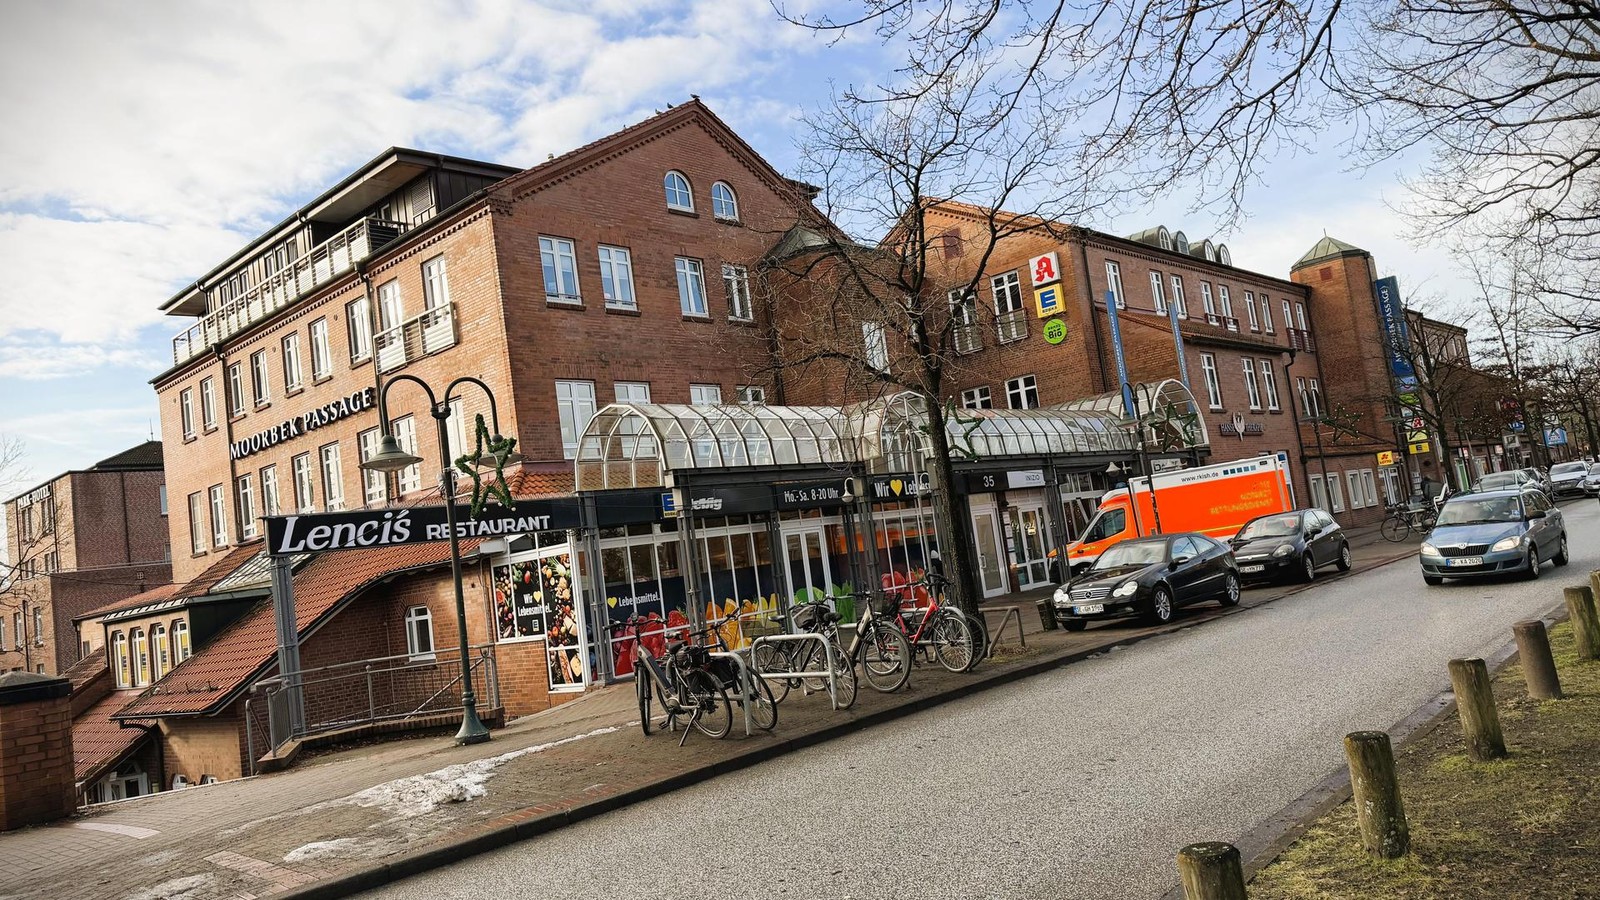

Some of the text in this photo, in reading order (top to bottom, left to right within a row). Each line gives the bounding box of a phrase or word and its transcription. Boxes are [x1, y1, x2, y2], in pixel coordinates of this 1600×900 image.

[230, 387, 373, 460] MOORBEK PASSAGE
[983, 475, 995, 487] 35
[1181, 472, 1219, 482] www.rkish.de
[811, 488, 827, 500] 8-20
[827, 487, 839, 499] Uhr
[874, 482, 889, 498] Wir
[426, 515, 551, 541] RESTAURANT
[523, 593, 533, 604] Wir
